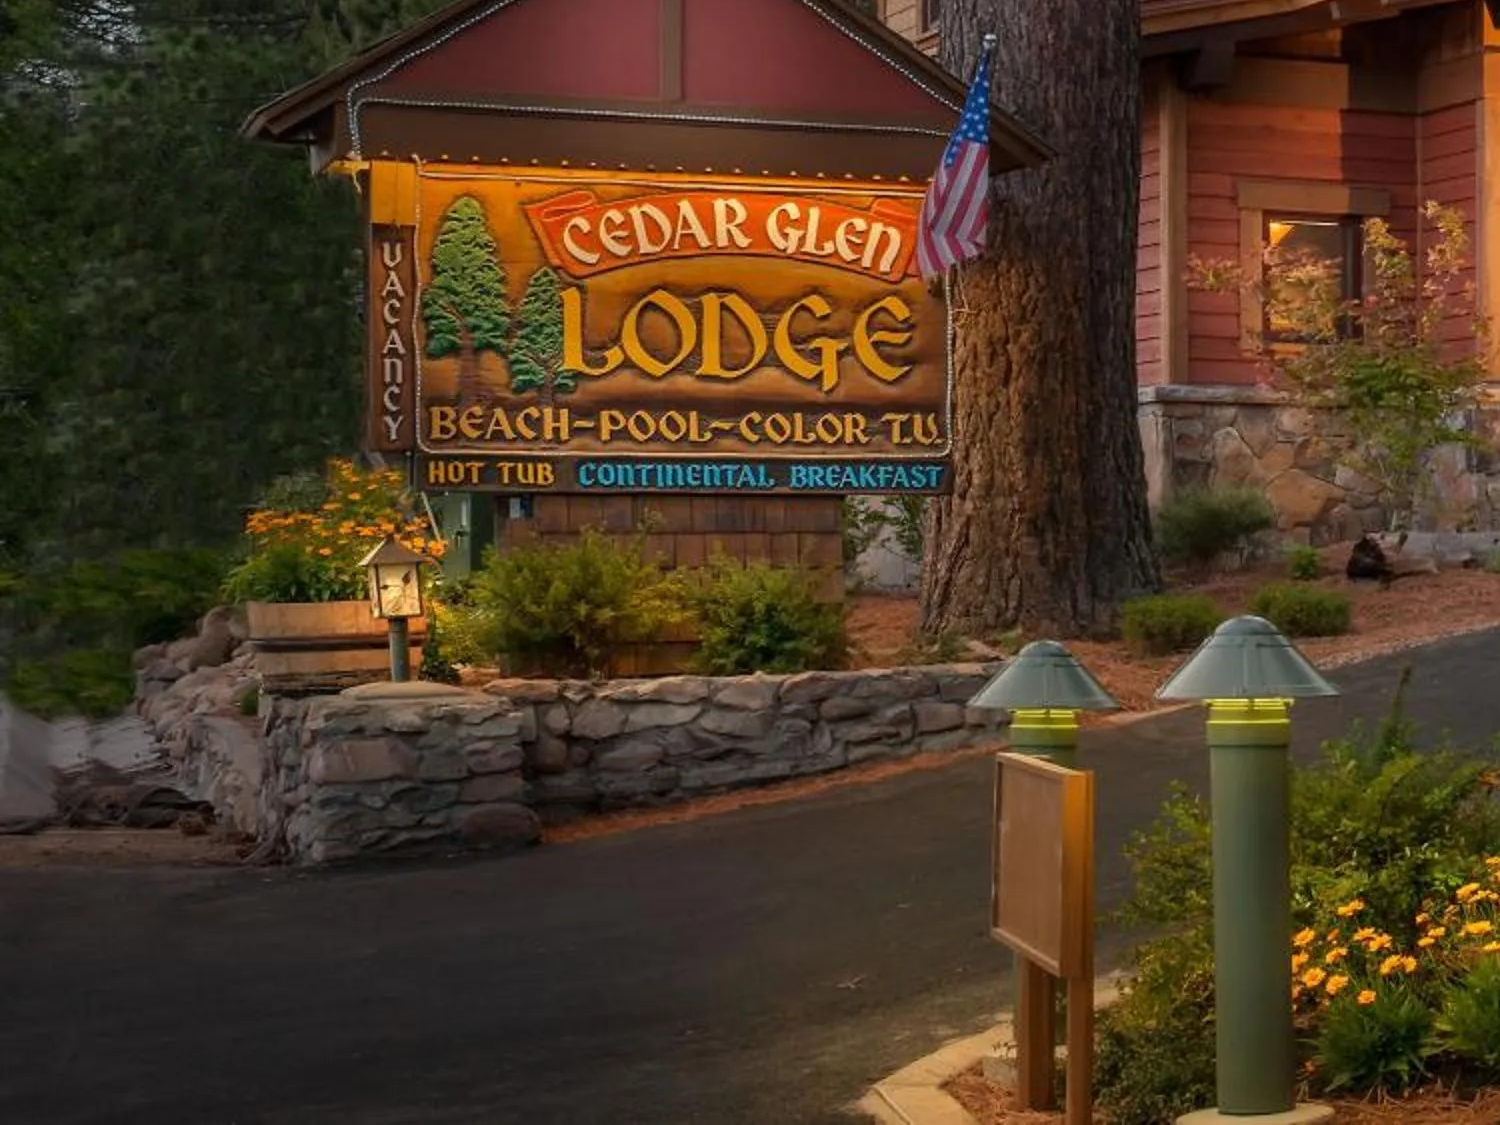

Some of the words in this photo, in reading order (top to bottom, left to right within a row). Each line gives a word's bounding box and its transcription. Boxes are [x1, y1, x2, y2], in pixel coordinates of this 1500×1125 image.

[563, 198, 752, 265] CEDAR
[767, 202, 901, 273] GLEN
[382, 242, 406, 441] VACANCY
[560, 286, 913, 392] LODGE
[428, 460, 485, 485] HOT
[497, 461, 555, 487] TUB
[577, 461, 776, 489] CONTINENTAL
[789, 463, 945, 489] BREAKFAST
